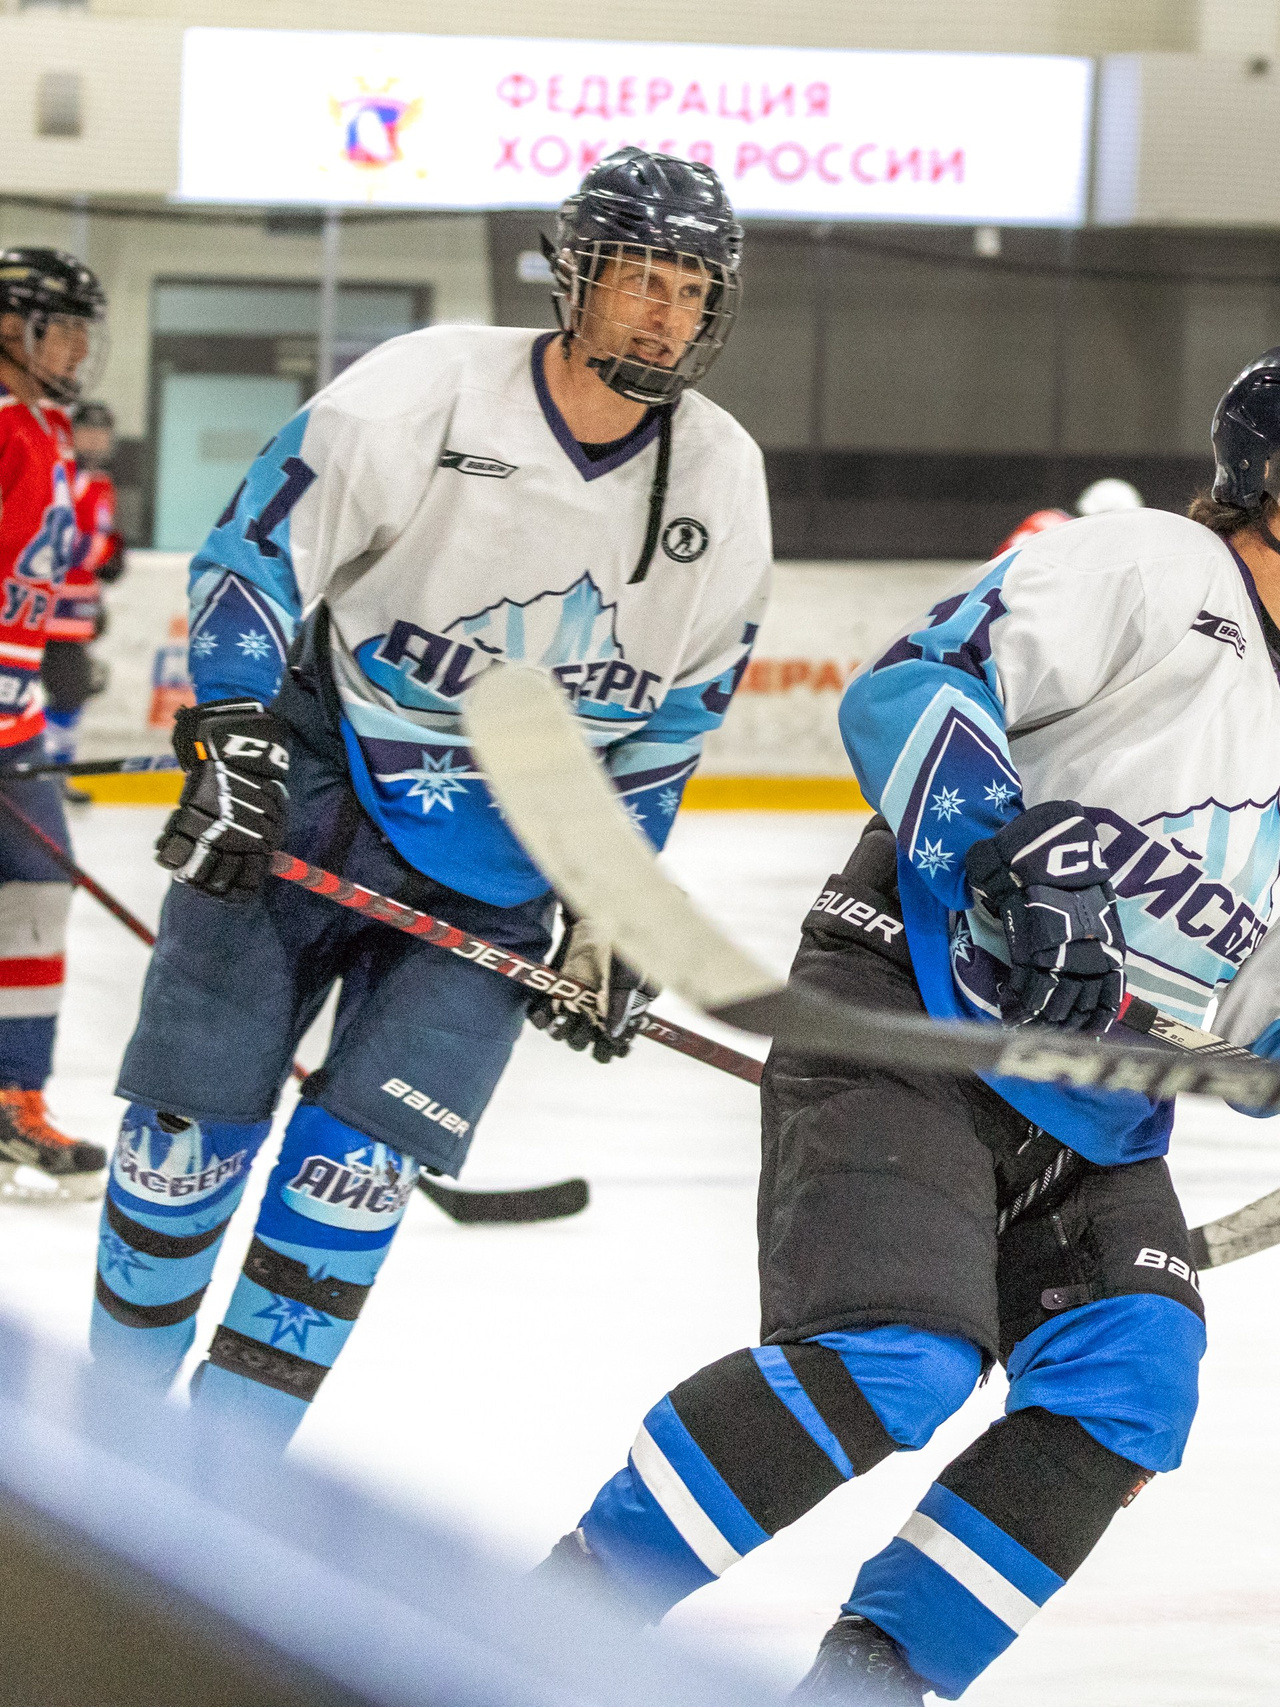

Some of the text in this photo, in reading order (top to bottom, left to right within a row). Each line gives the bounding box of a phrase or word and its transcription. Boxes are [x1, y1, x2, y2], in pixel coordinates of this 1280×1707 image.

[496, 72, 833, 124] ФЕДЕРАЦИЯ
[494, 134, 966, 186] ХОКЯ РОССИИ
[811, 889, 905, 944] AUER
[379, 1077, 471, 1139] BAUER
